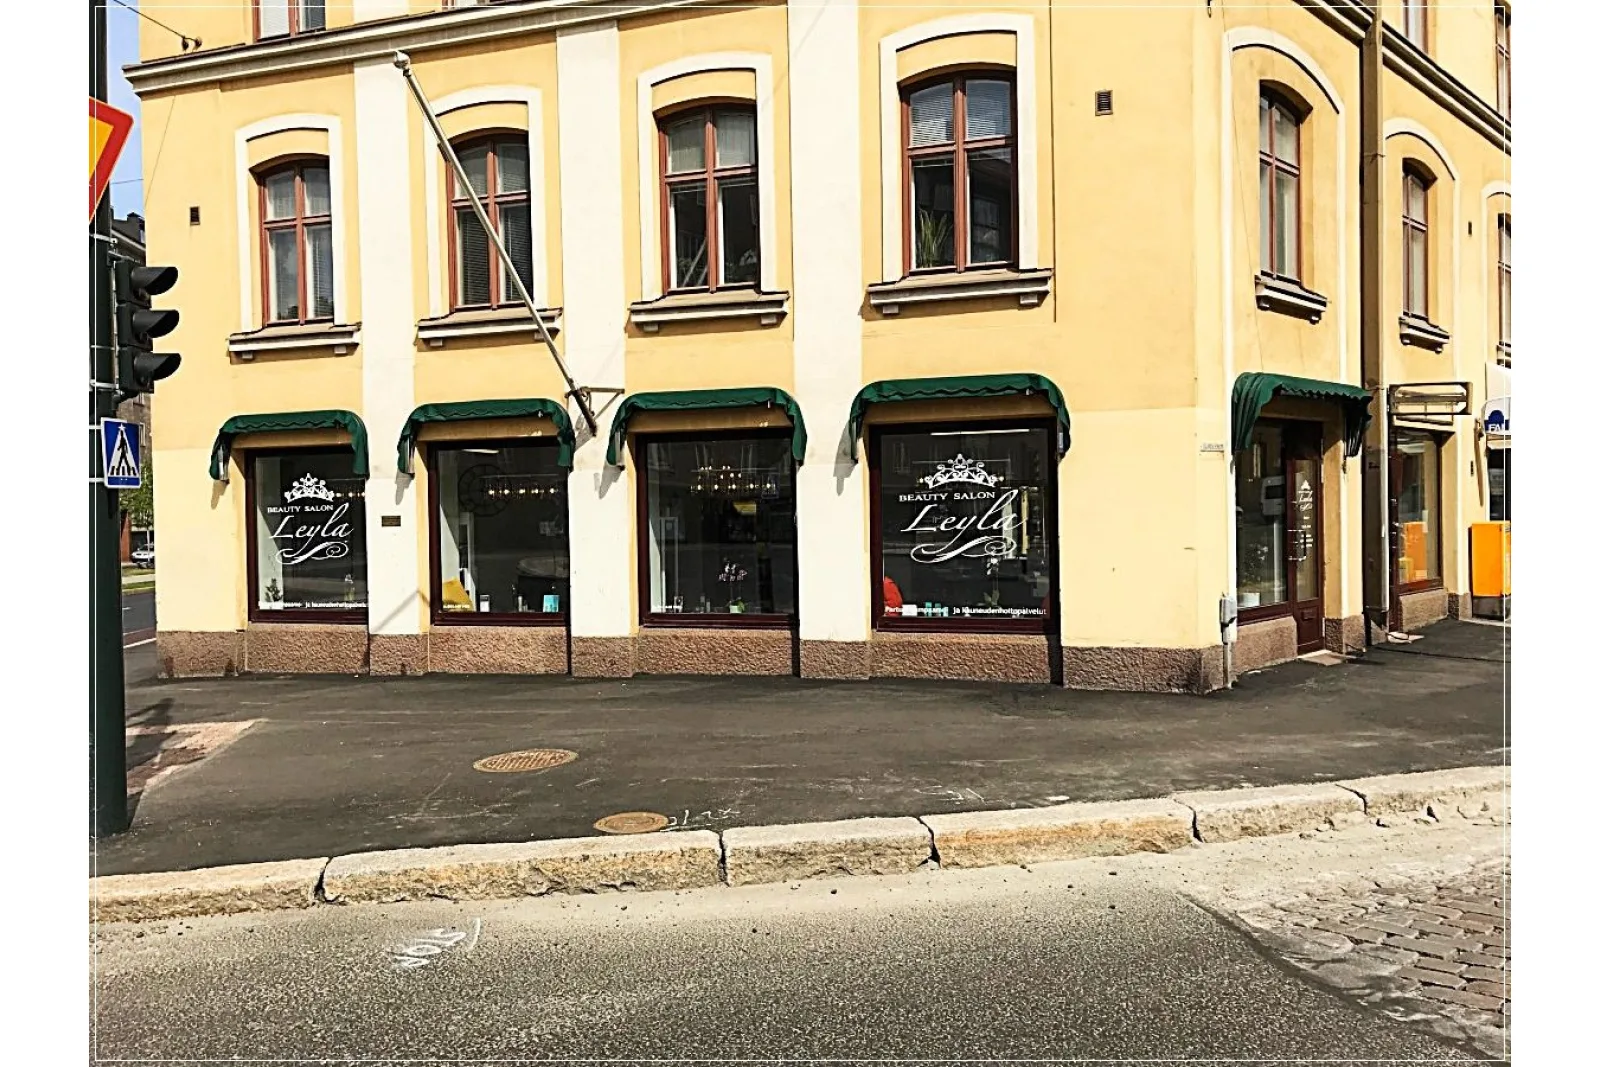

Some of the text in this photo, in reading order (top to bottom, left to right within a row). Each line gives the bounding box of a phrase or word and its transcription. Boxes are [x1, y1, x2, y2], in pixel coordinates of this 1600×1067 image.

[267, 504, 334, 514] BEAUTY SALON
[899, 491, 996, 502] BEAUTY SALON
[268, 502, 355, 557] Leyla
[900, 489, 1029, 555] Leyla
